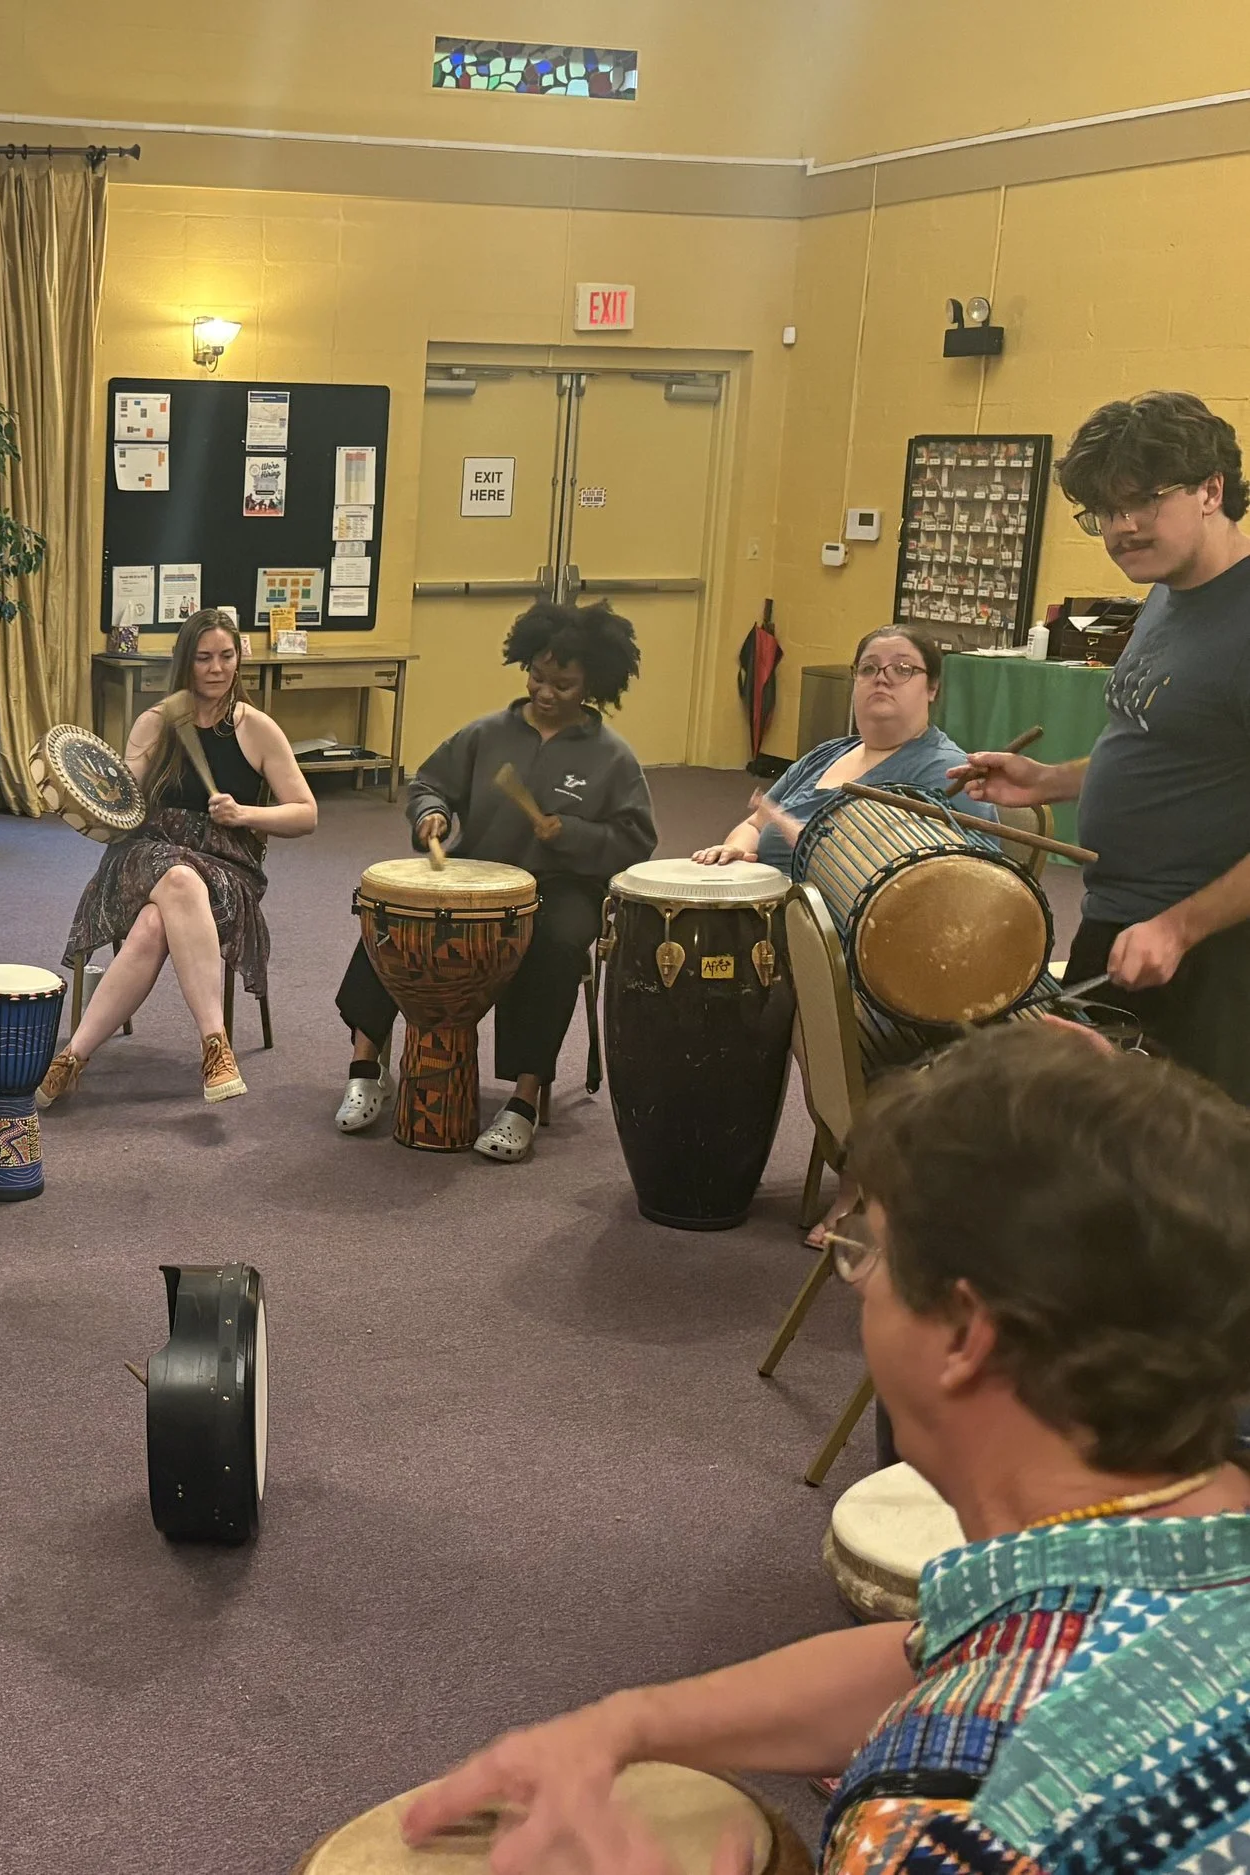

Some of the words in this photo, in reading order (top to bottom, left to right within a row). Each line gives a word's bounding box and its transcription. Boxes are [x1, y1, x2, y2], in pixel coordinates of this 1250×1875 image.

[589, 291, 627, 325] EXIT
[475, 471, 503, 483] EXIT
[470, 489, 505, 501] HERE
